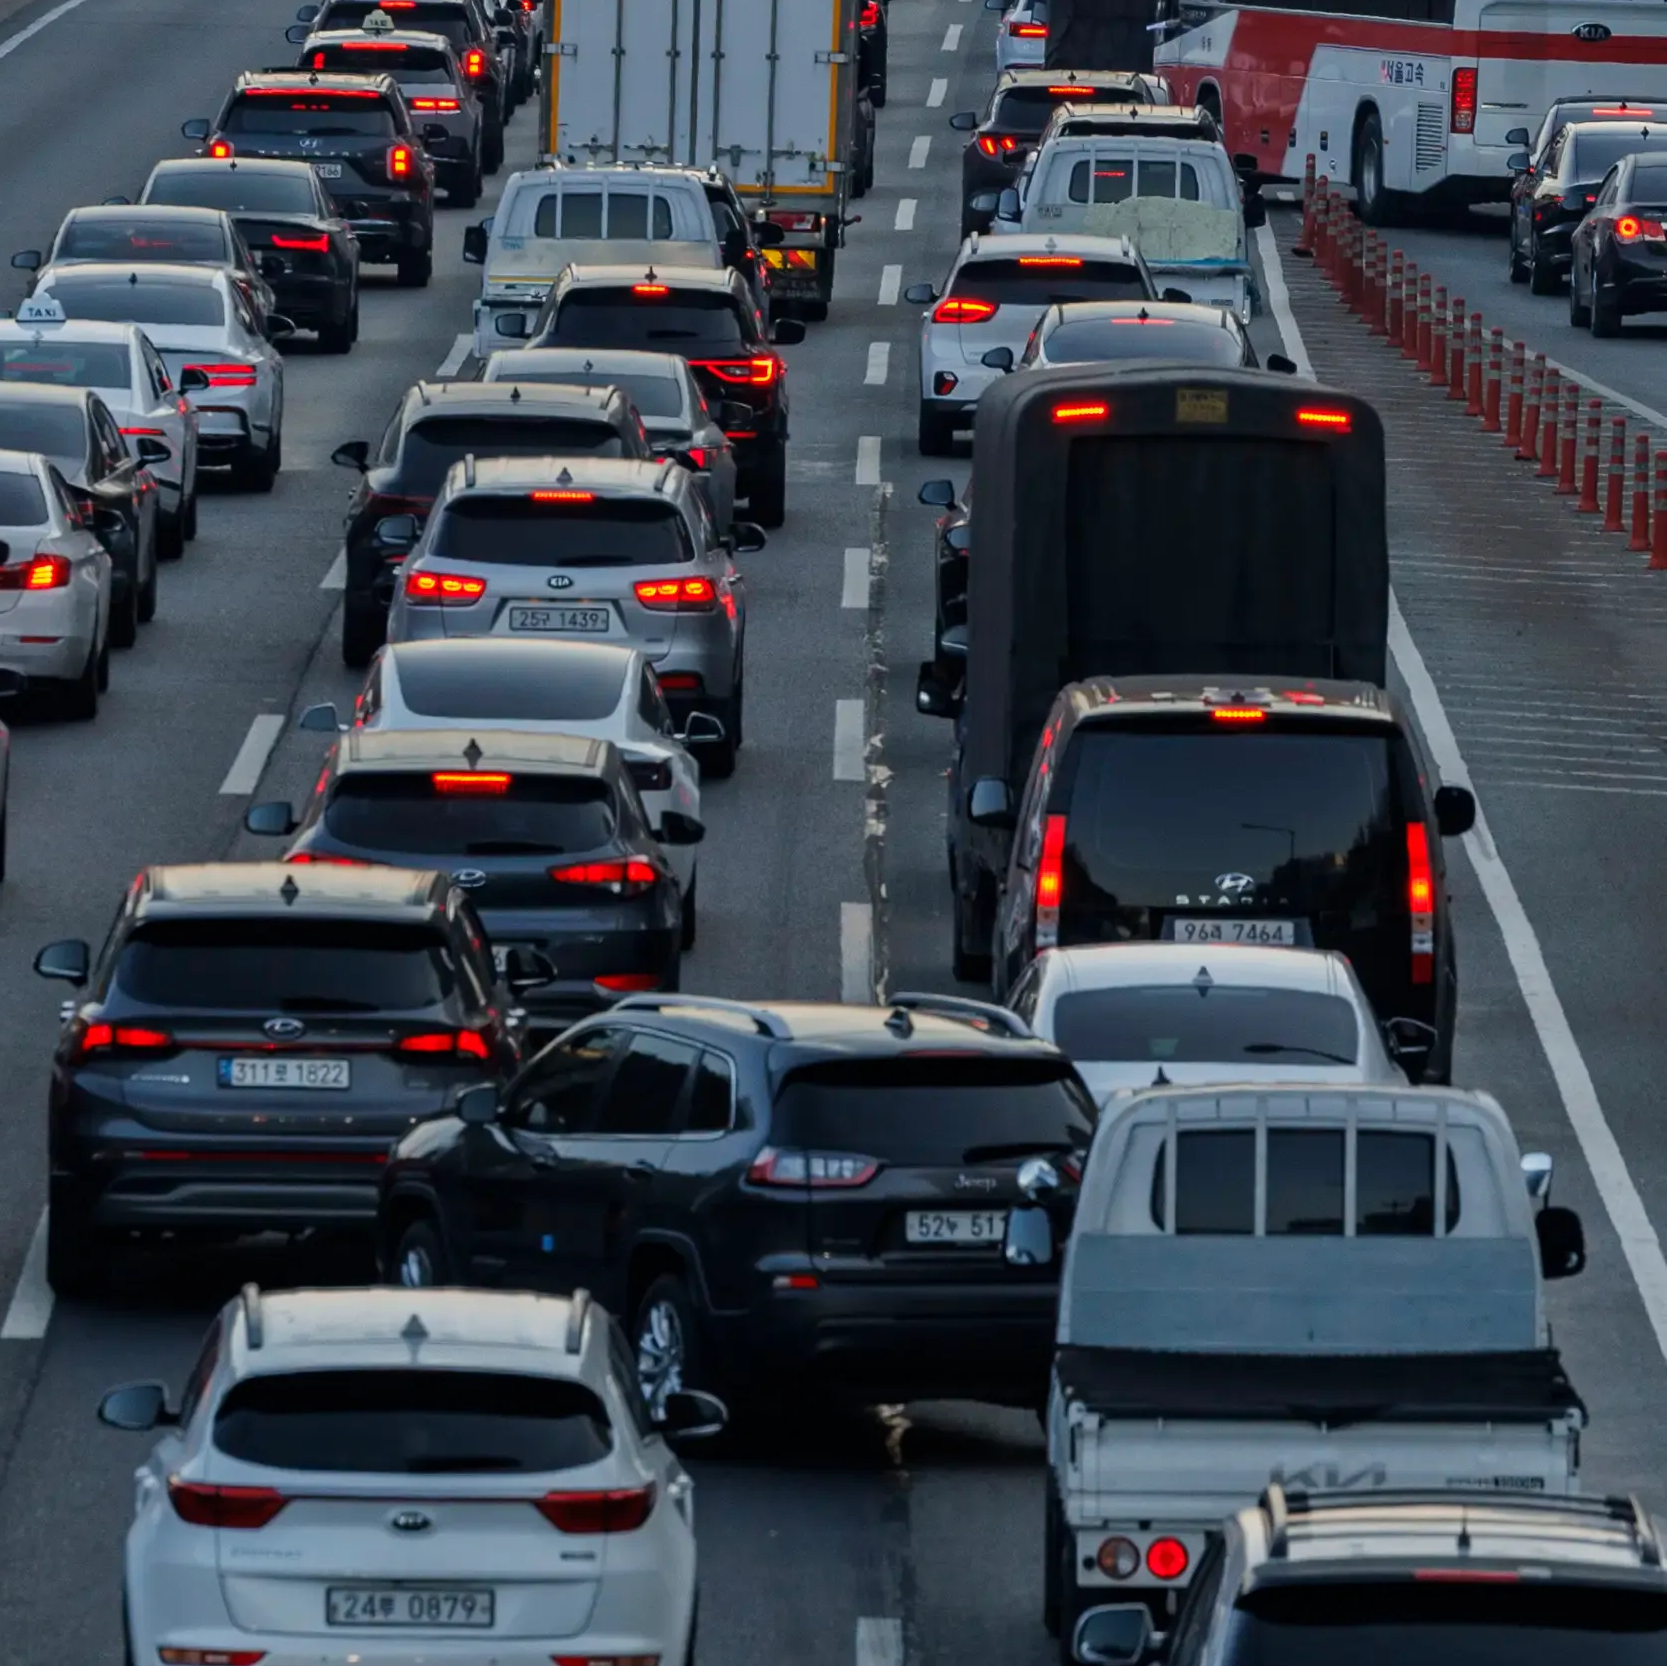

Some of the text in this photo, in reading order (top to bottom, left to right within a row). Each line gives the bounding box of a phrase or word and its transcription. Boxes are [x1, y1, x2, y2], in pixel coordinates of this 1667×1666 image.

[28, 307, 57, 318] TAXI
[559, 612, 600, 628] 1439
[1232, 923, 1284, 942] 7464
[295, 1063, 345, 1085] 1822
[954, 1174, 997, 1192] Jeep
[407, 1594, 477, 1621] 0879
